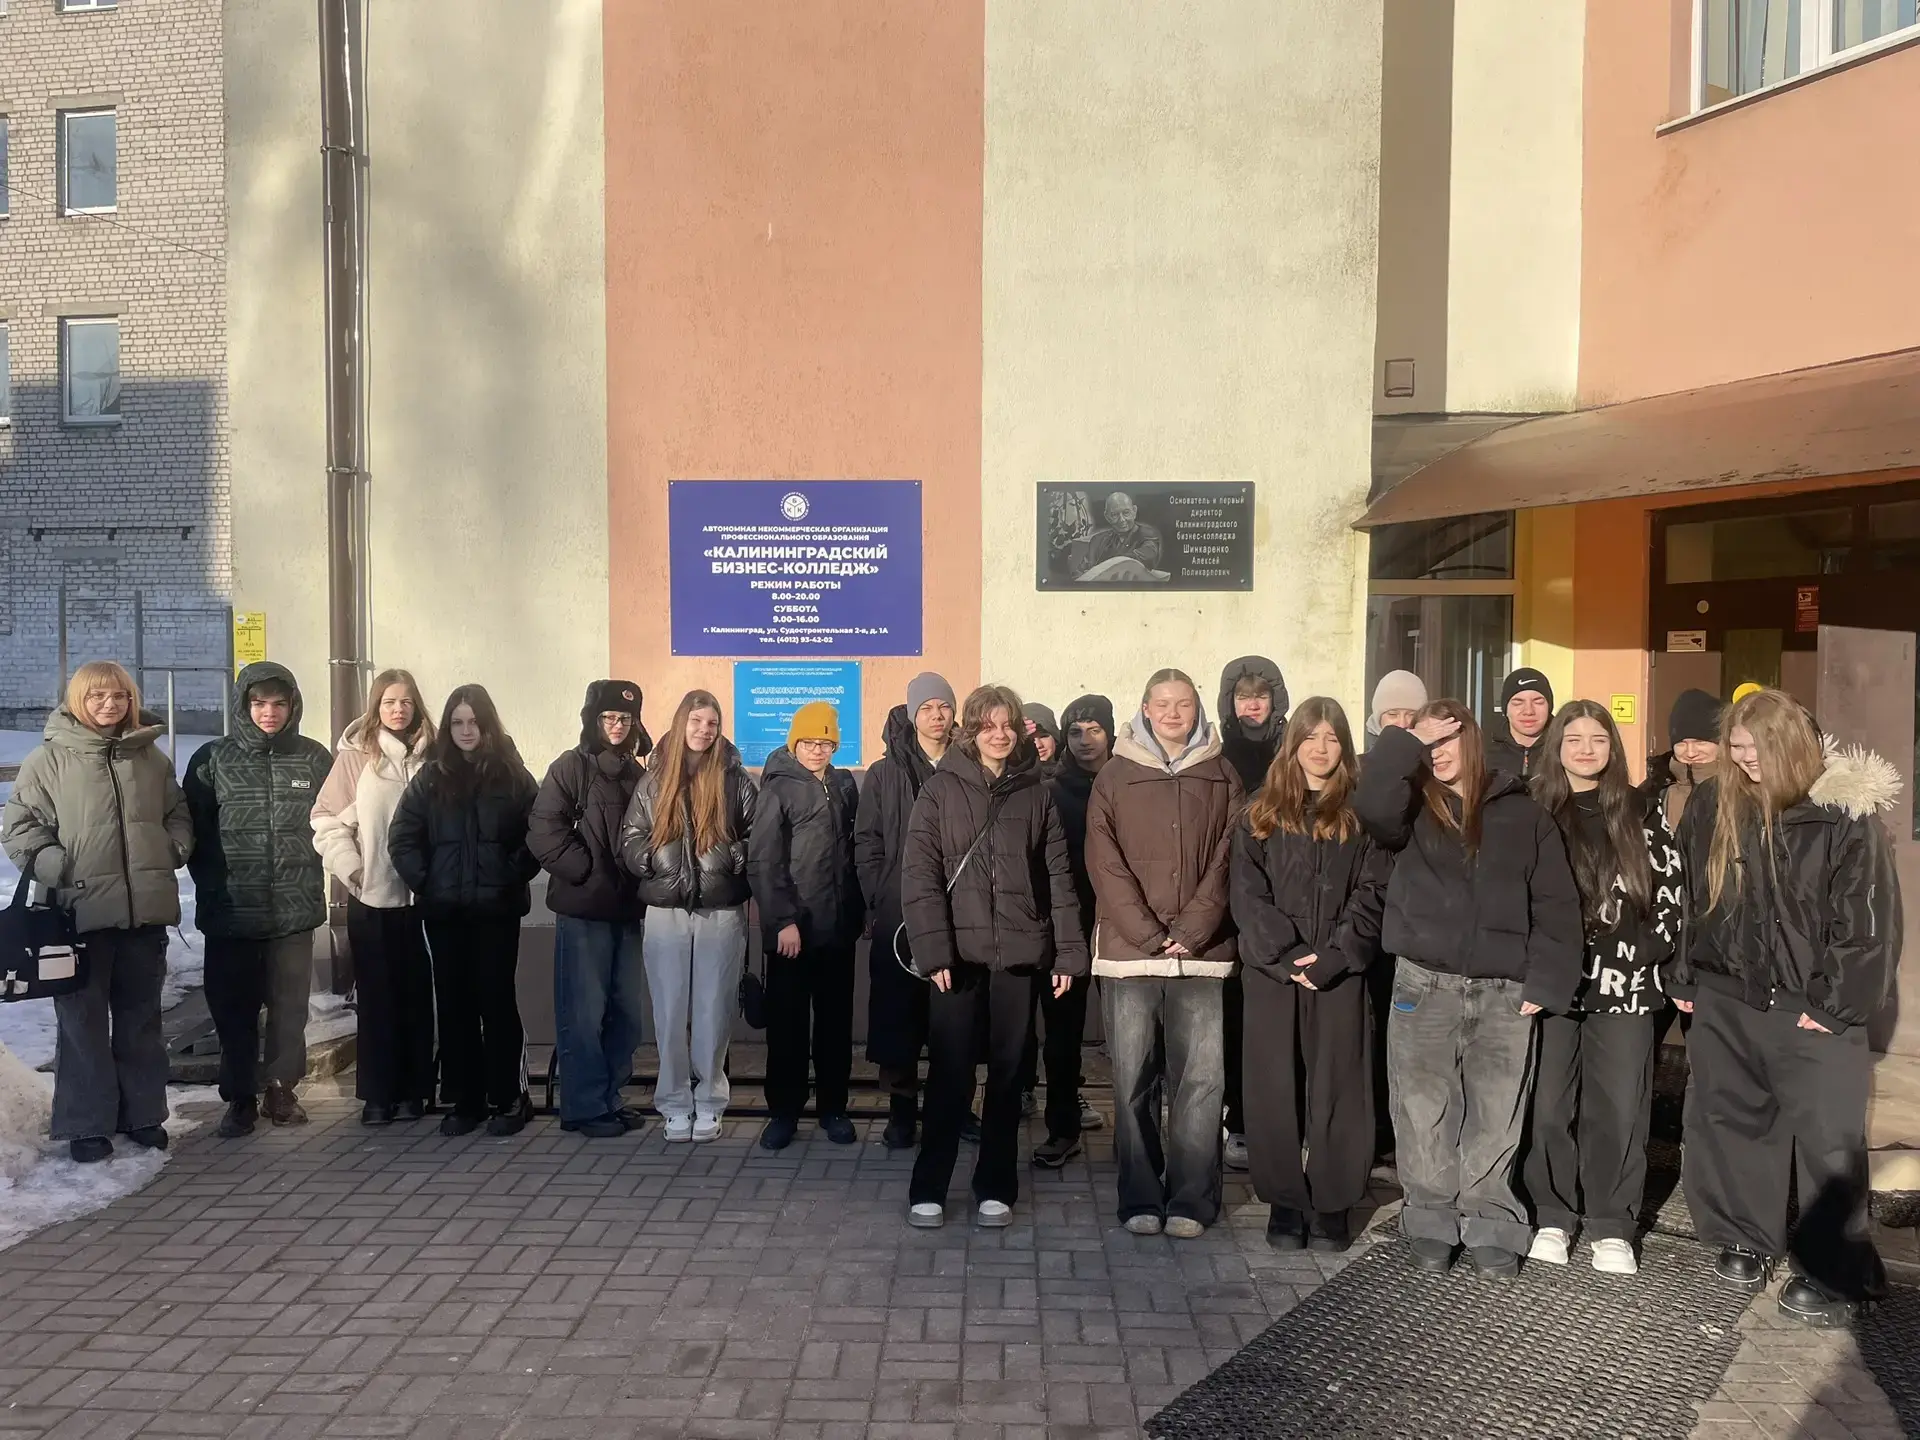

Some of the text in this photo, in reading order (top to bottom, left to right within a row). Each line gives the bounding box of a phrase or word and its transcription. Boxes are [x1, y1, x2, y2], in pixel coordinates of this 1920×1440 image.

[1169, 496, 1210, 504] Основатель
[1220, 496, 1245, 506] первый
[1190, 509, 1223, 518] директор
[1176, 520, 1238, 530] Калининградского
[1176, 532, 1236, 541] бизнес-колледжа
[704, 544, 888, 560] «КАЛИНИНГРАДСКИЙ
[1184, 544, 1230, 554] Шинкаренко
[1192, 556, 1220, 564] Алексей
[712, 562, 880, 577] БИЗНЕС-КОЛЛЕДЖ»
[1182, 568, 1230, 577] Поликарпович
[750, 580, 841, 590] РЕЖИМ РАБОТЫ
[774, 605, 818, 613] СУББОТА
